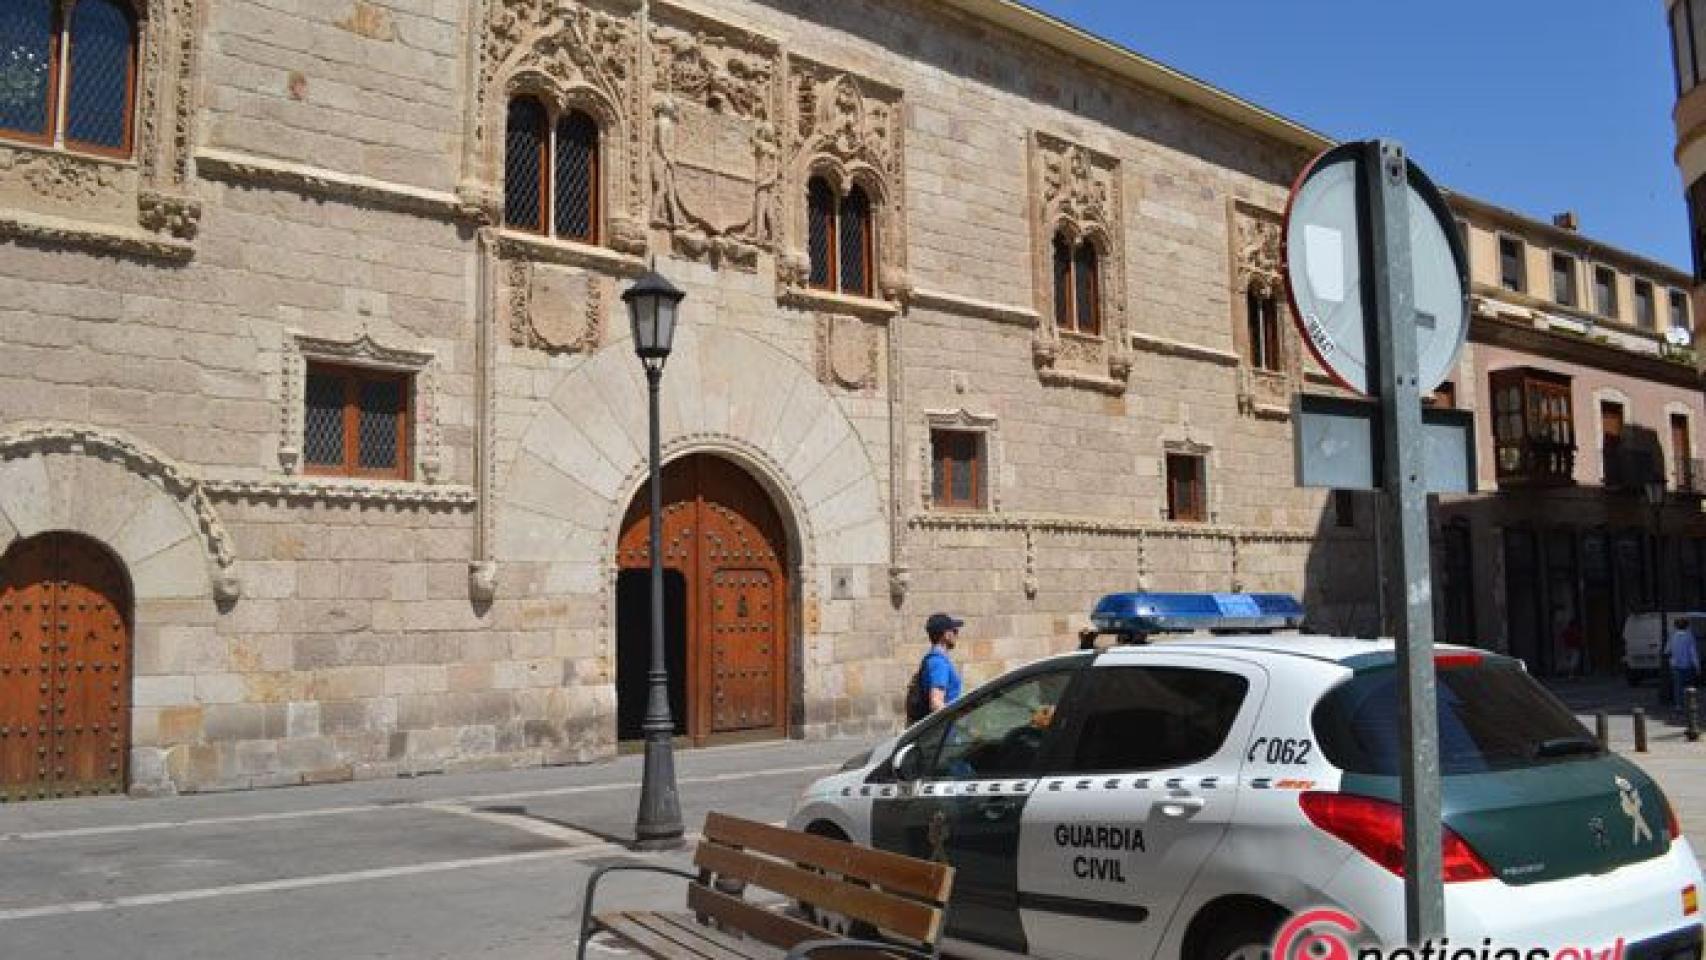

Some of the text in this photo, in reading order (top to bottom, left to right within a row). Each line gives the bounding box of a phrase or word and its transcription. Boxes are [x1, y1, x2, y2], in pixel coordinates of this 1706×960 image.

[1267, 737, 1312, 765] 062
[1055, 823, 1145, 853] GUARDIA
[1074, 856, 1126, 883] CIVIL
